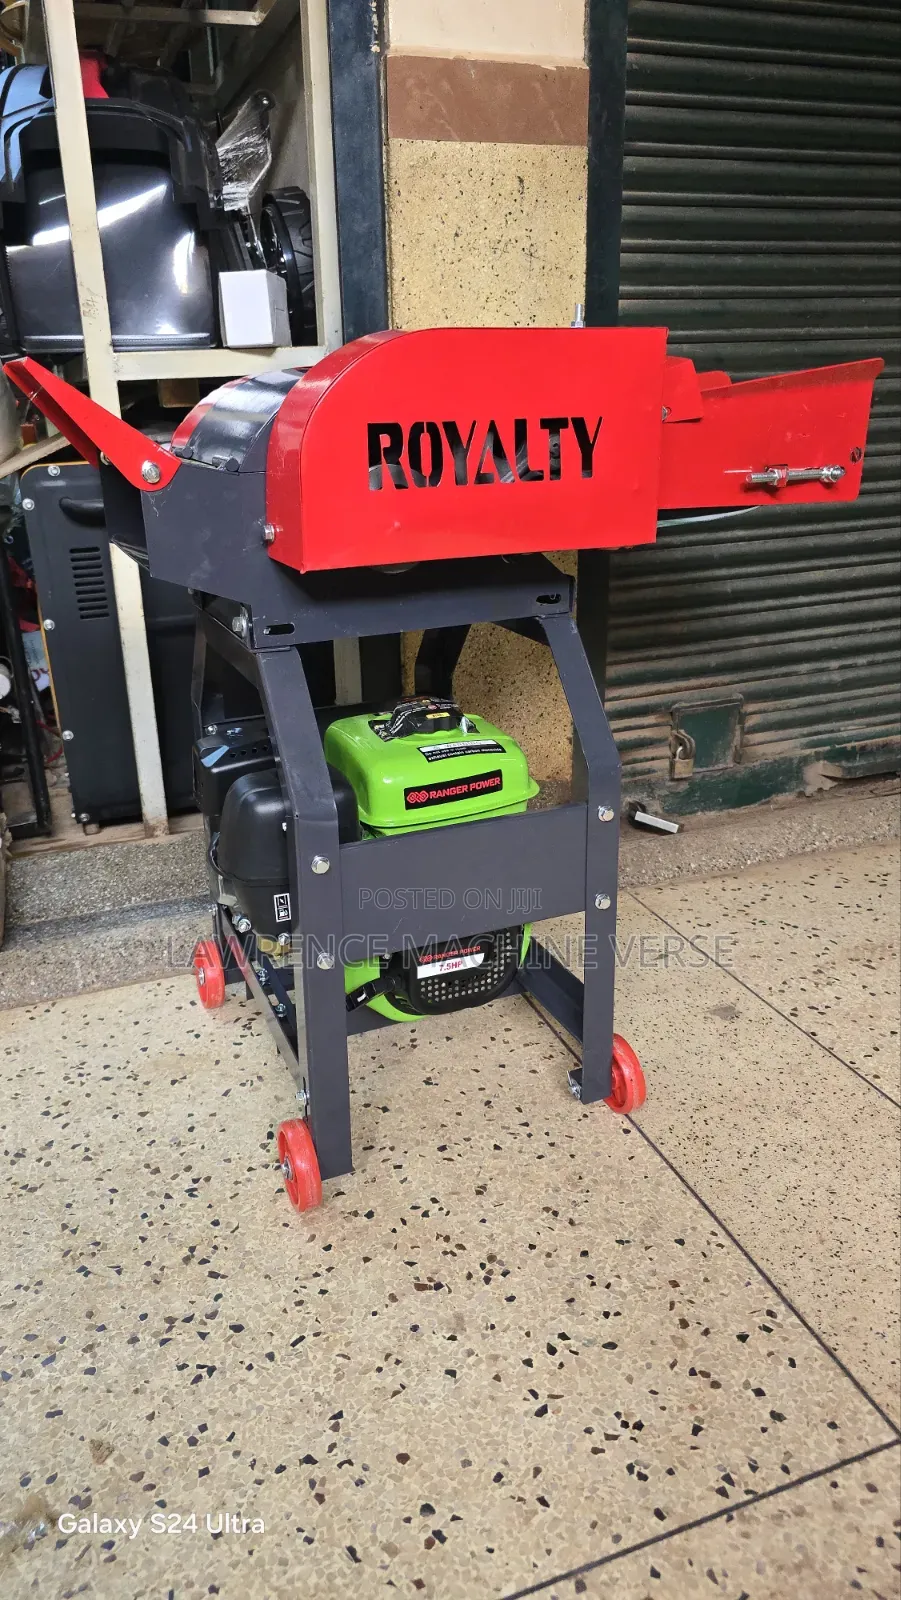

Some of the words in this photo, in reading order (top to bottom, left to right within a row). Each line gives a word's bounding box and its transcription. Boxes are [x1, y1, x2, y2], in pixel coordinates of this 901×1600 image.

[367, 416, 603, 490] ROYALTY
[429, 784, 469, 799] RANGER
[469, 776, 501, 791] POWER
[439, 961, 463, 972] 7.5HP
